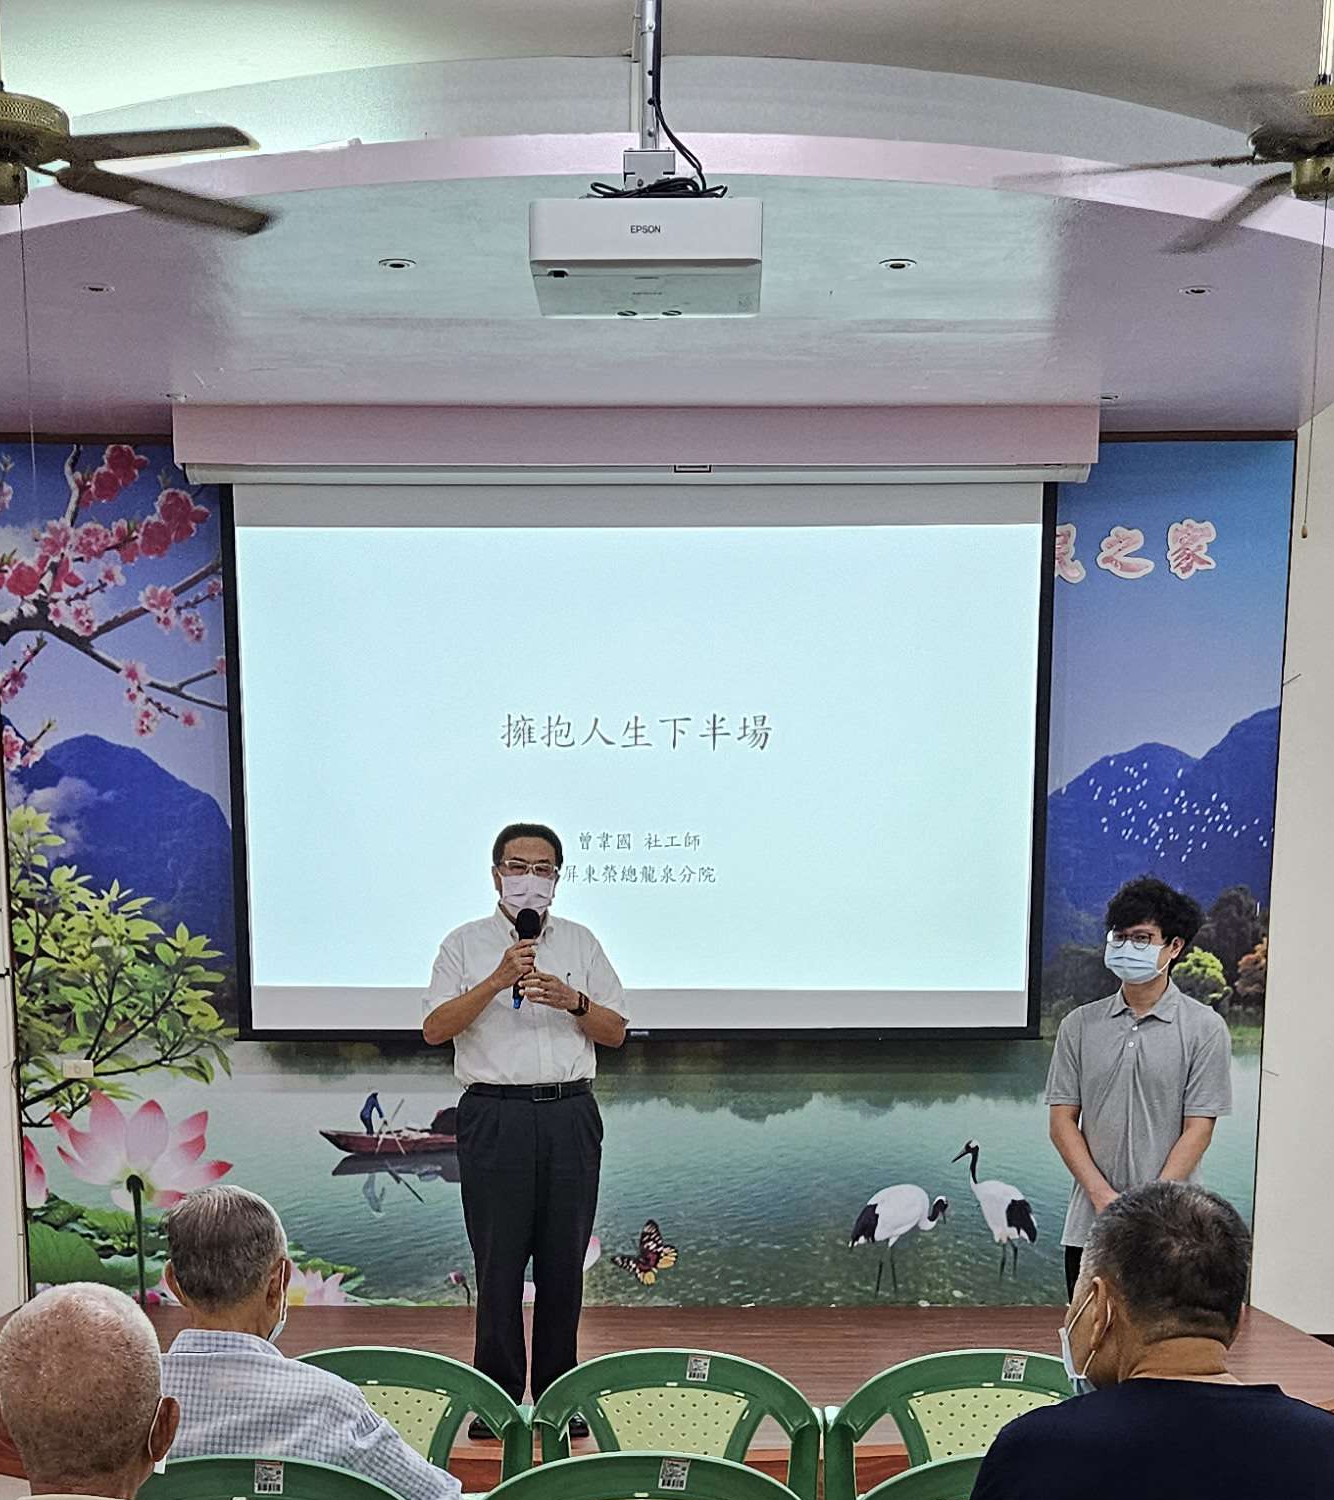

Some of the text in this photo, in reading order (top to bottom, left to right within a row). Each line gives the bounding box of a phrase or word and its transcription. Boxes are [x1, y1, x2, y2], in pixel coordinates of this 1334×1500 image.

[630, 224, 661, 234] EPSON
[501, 713, 774, 752] 擁抱人生下半場
[644, 831, 701, 852] 社工師
[563, 864, 717, 884] 屏東榮總龍泉分院
